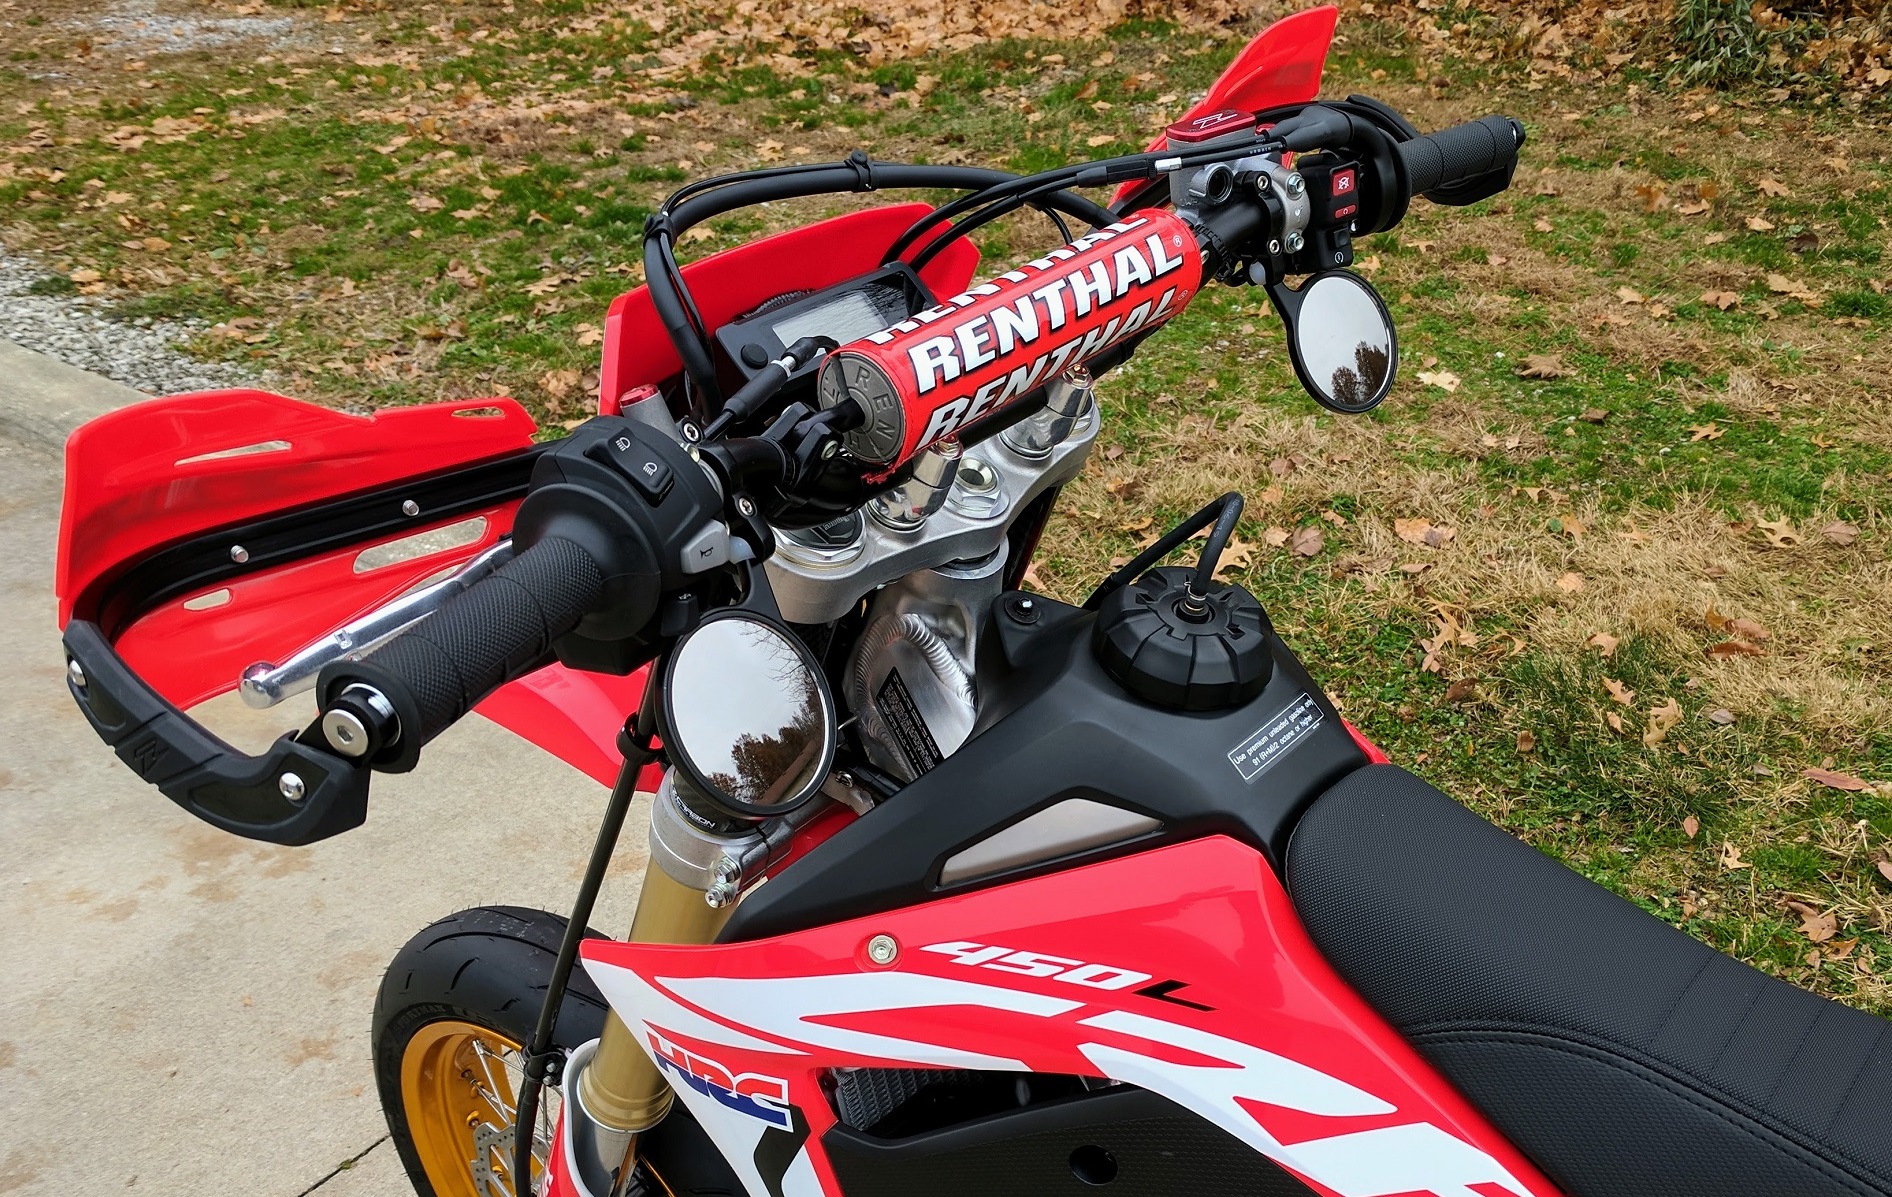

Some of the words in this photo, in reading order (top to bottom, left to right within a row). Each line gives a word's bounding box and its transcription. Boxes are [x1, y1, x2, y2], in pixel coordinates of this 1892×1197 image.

[907, 233, 1184, 395] RENTHAL
[915, 285, 1178, 452] RENTHAL
[1233, 752, 1247, 765] Use
[1246, 735, 1269, 757] premium
[1268, 718, 1290, 738] unleaded
[1288, 705, 1306, 723] gasoline
[1252, 756, 1261, 766] 91
[1279, 729, 1296, 745] octane
[1294, 724, 1301, 732] or
[1299, 713, 1313, 728] higher
[645, 1028, 793, 1132] HRC
